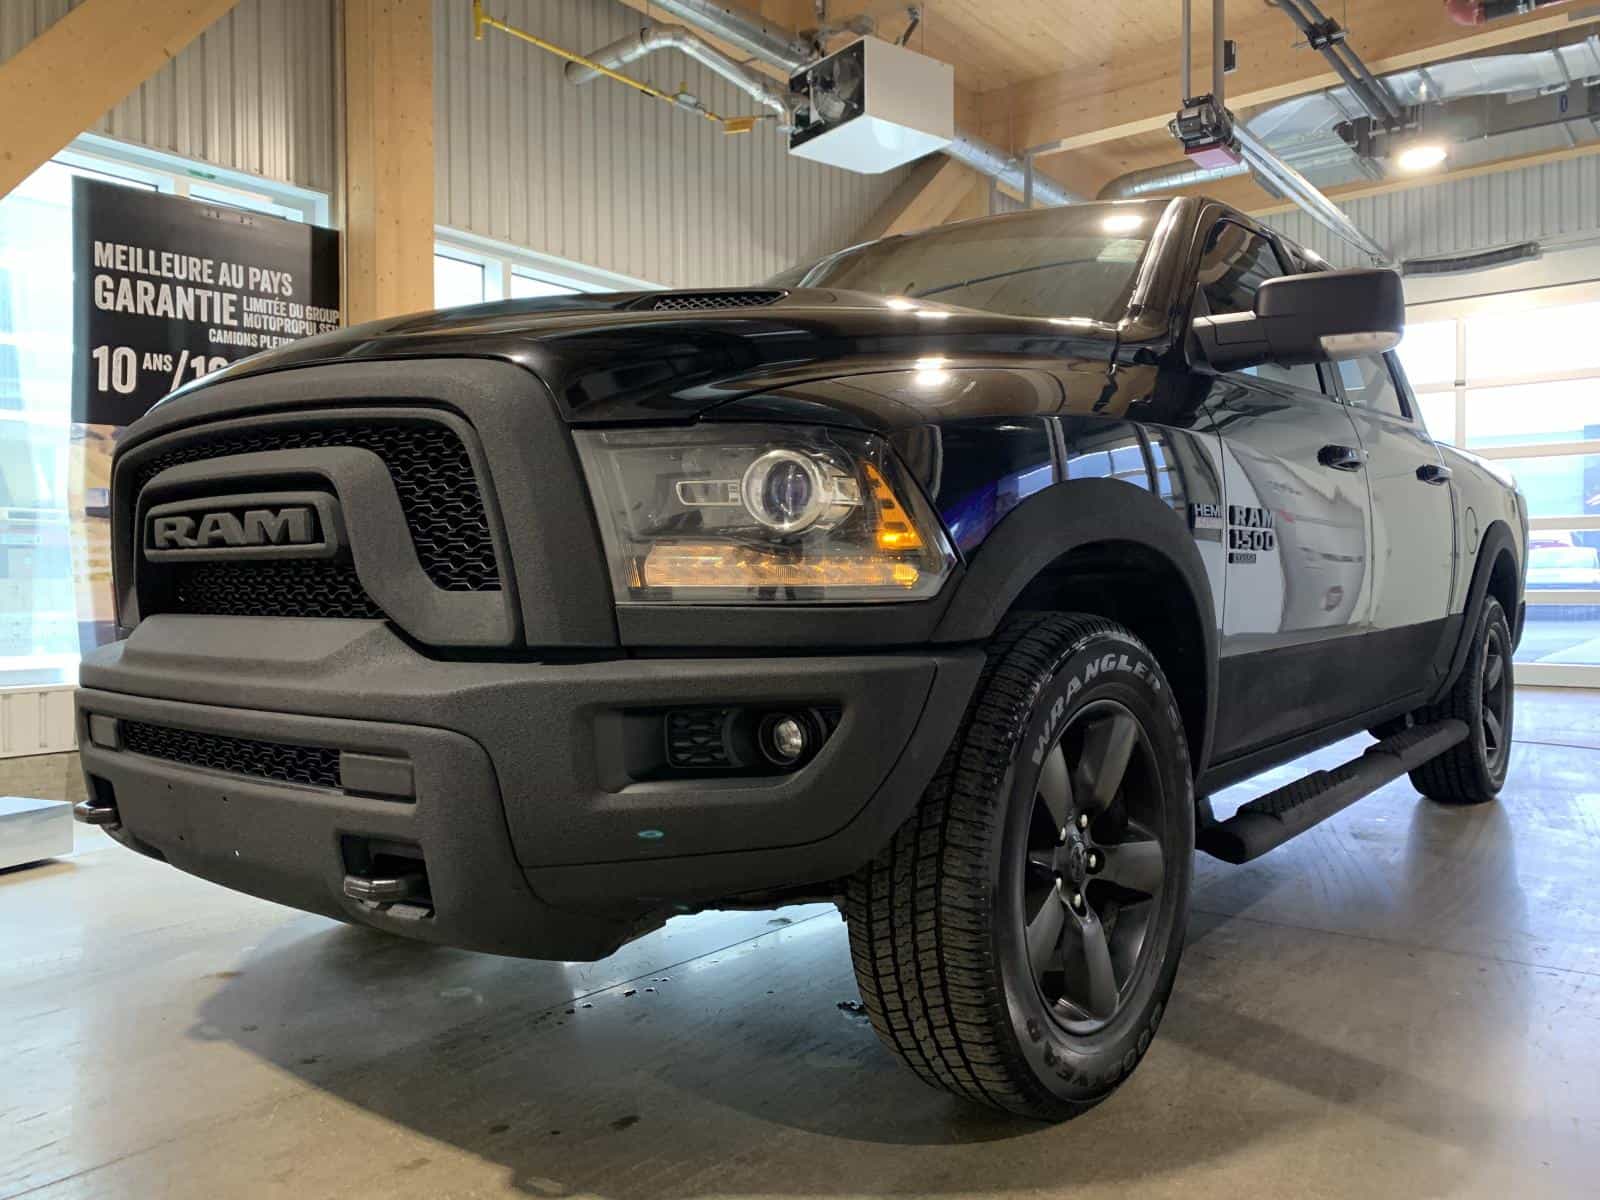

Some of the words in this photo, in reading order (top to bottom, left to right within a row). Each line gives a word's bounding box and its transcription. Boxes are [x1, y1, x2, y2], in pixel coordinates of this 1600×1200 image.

[94, 240, 214, 284] MEILLEURE
[218, 262, 244, 288] AU
[249, 267, 293, 297] PAYS
[94, 275, 238, 326] GARANTIE
[243, 295, 287, 317] LIMITÉE
[289, 302, 303, 319] DU
[208, 328, 258, 348] CAMIONS
[92, 345, 137, 394] 10
[154, 507, 312, 548] RAM
[1229, 505, 1276, 528] RAM
[1229, 529, 1276, 551] 1500
